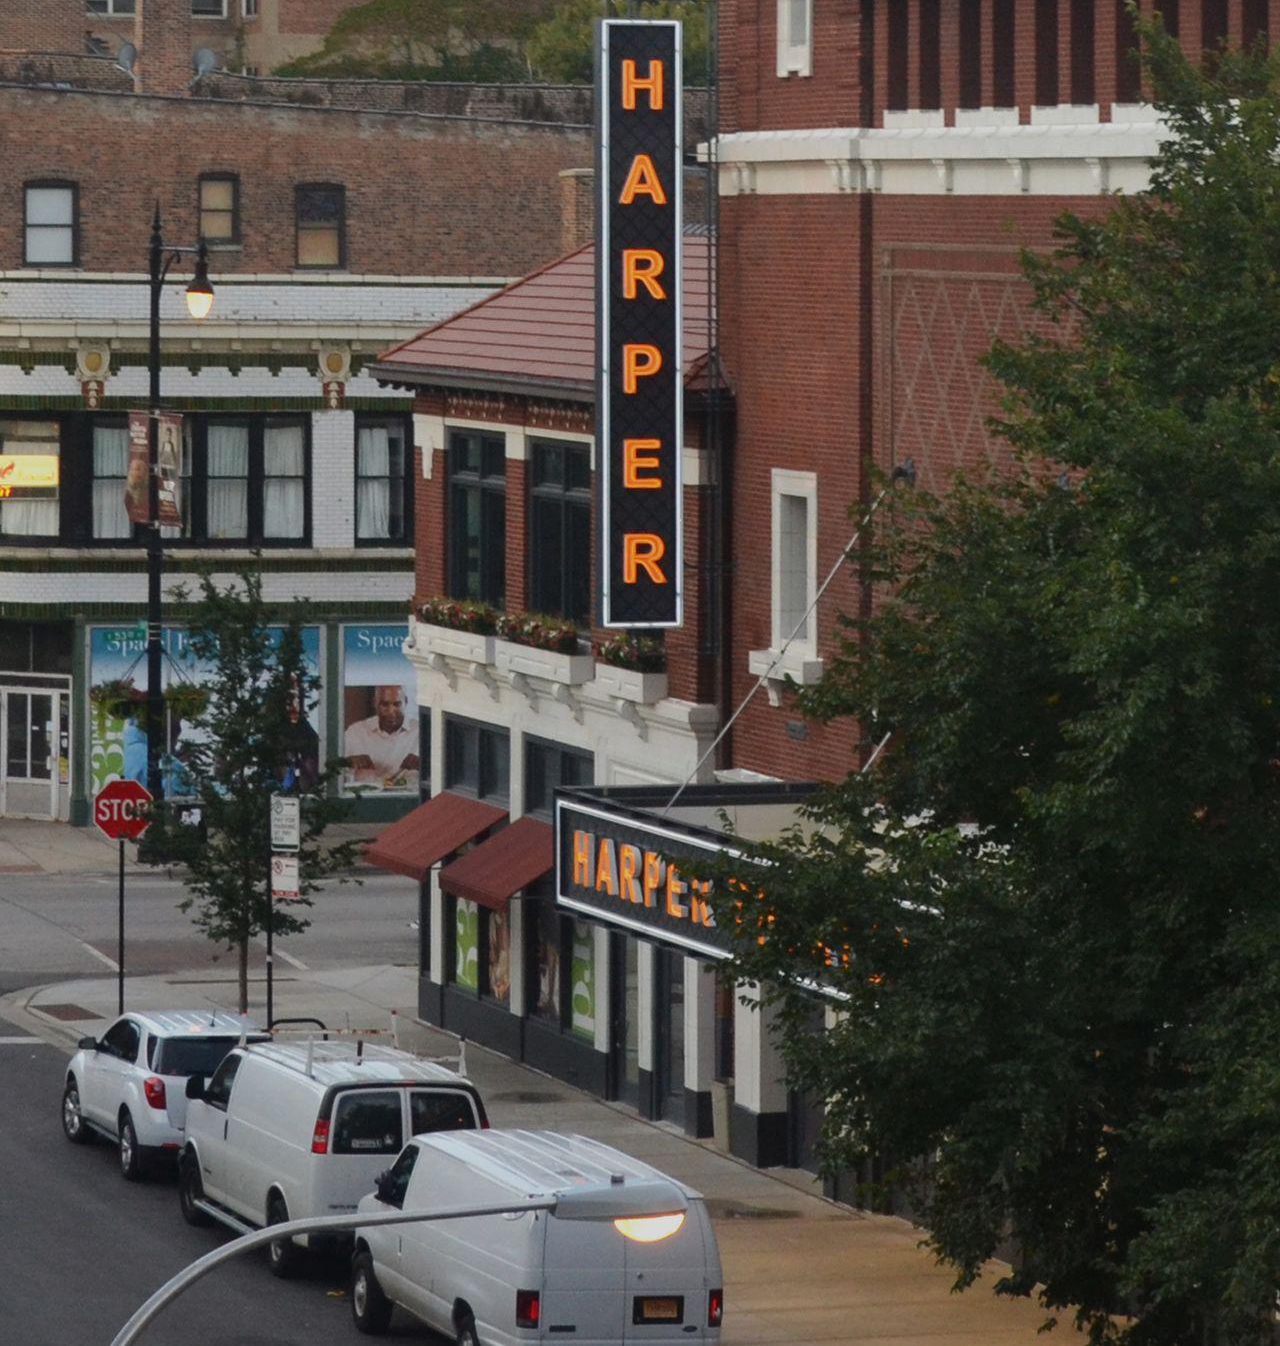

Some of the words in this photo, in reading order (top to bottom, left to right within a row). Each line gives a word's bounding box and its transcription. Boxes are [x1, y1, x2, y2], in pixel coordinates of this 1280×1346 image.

[619, 58, 667, 585] HARPER
[357, 629, 404, 654] Spac
[97, 798, 149, 822] STOP
[572, 829, 717, 929] HARPER
